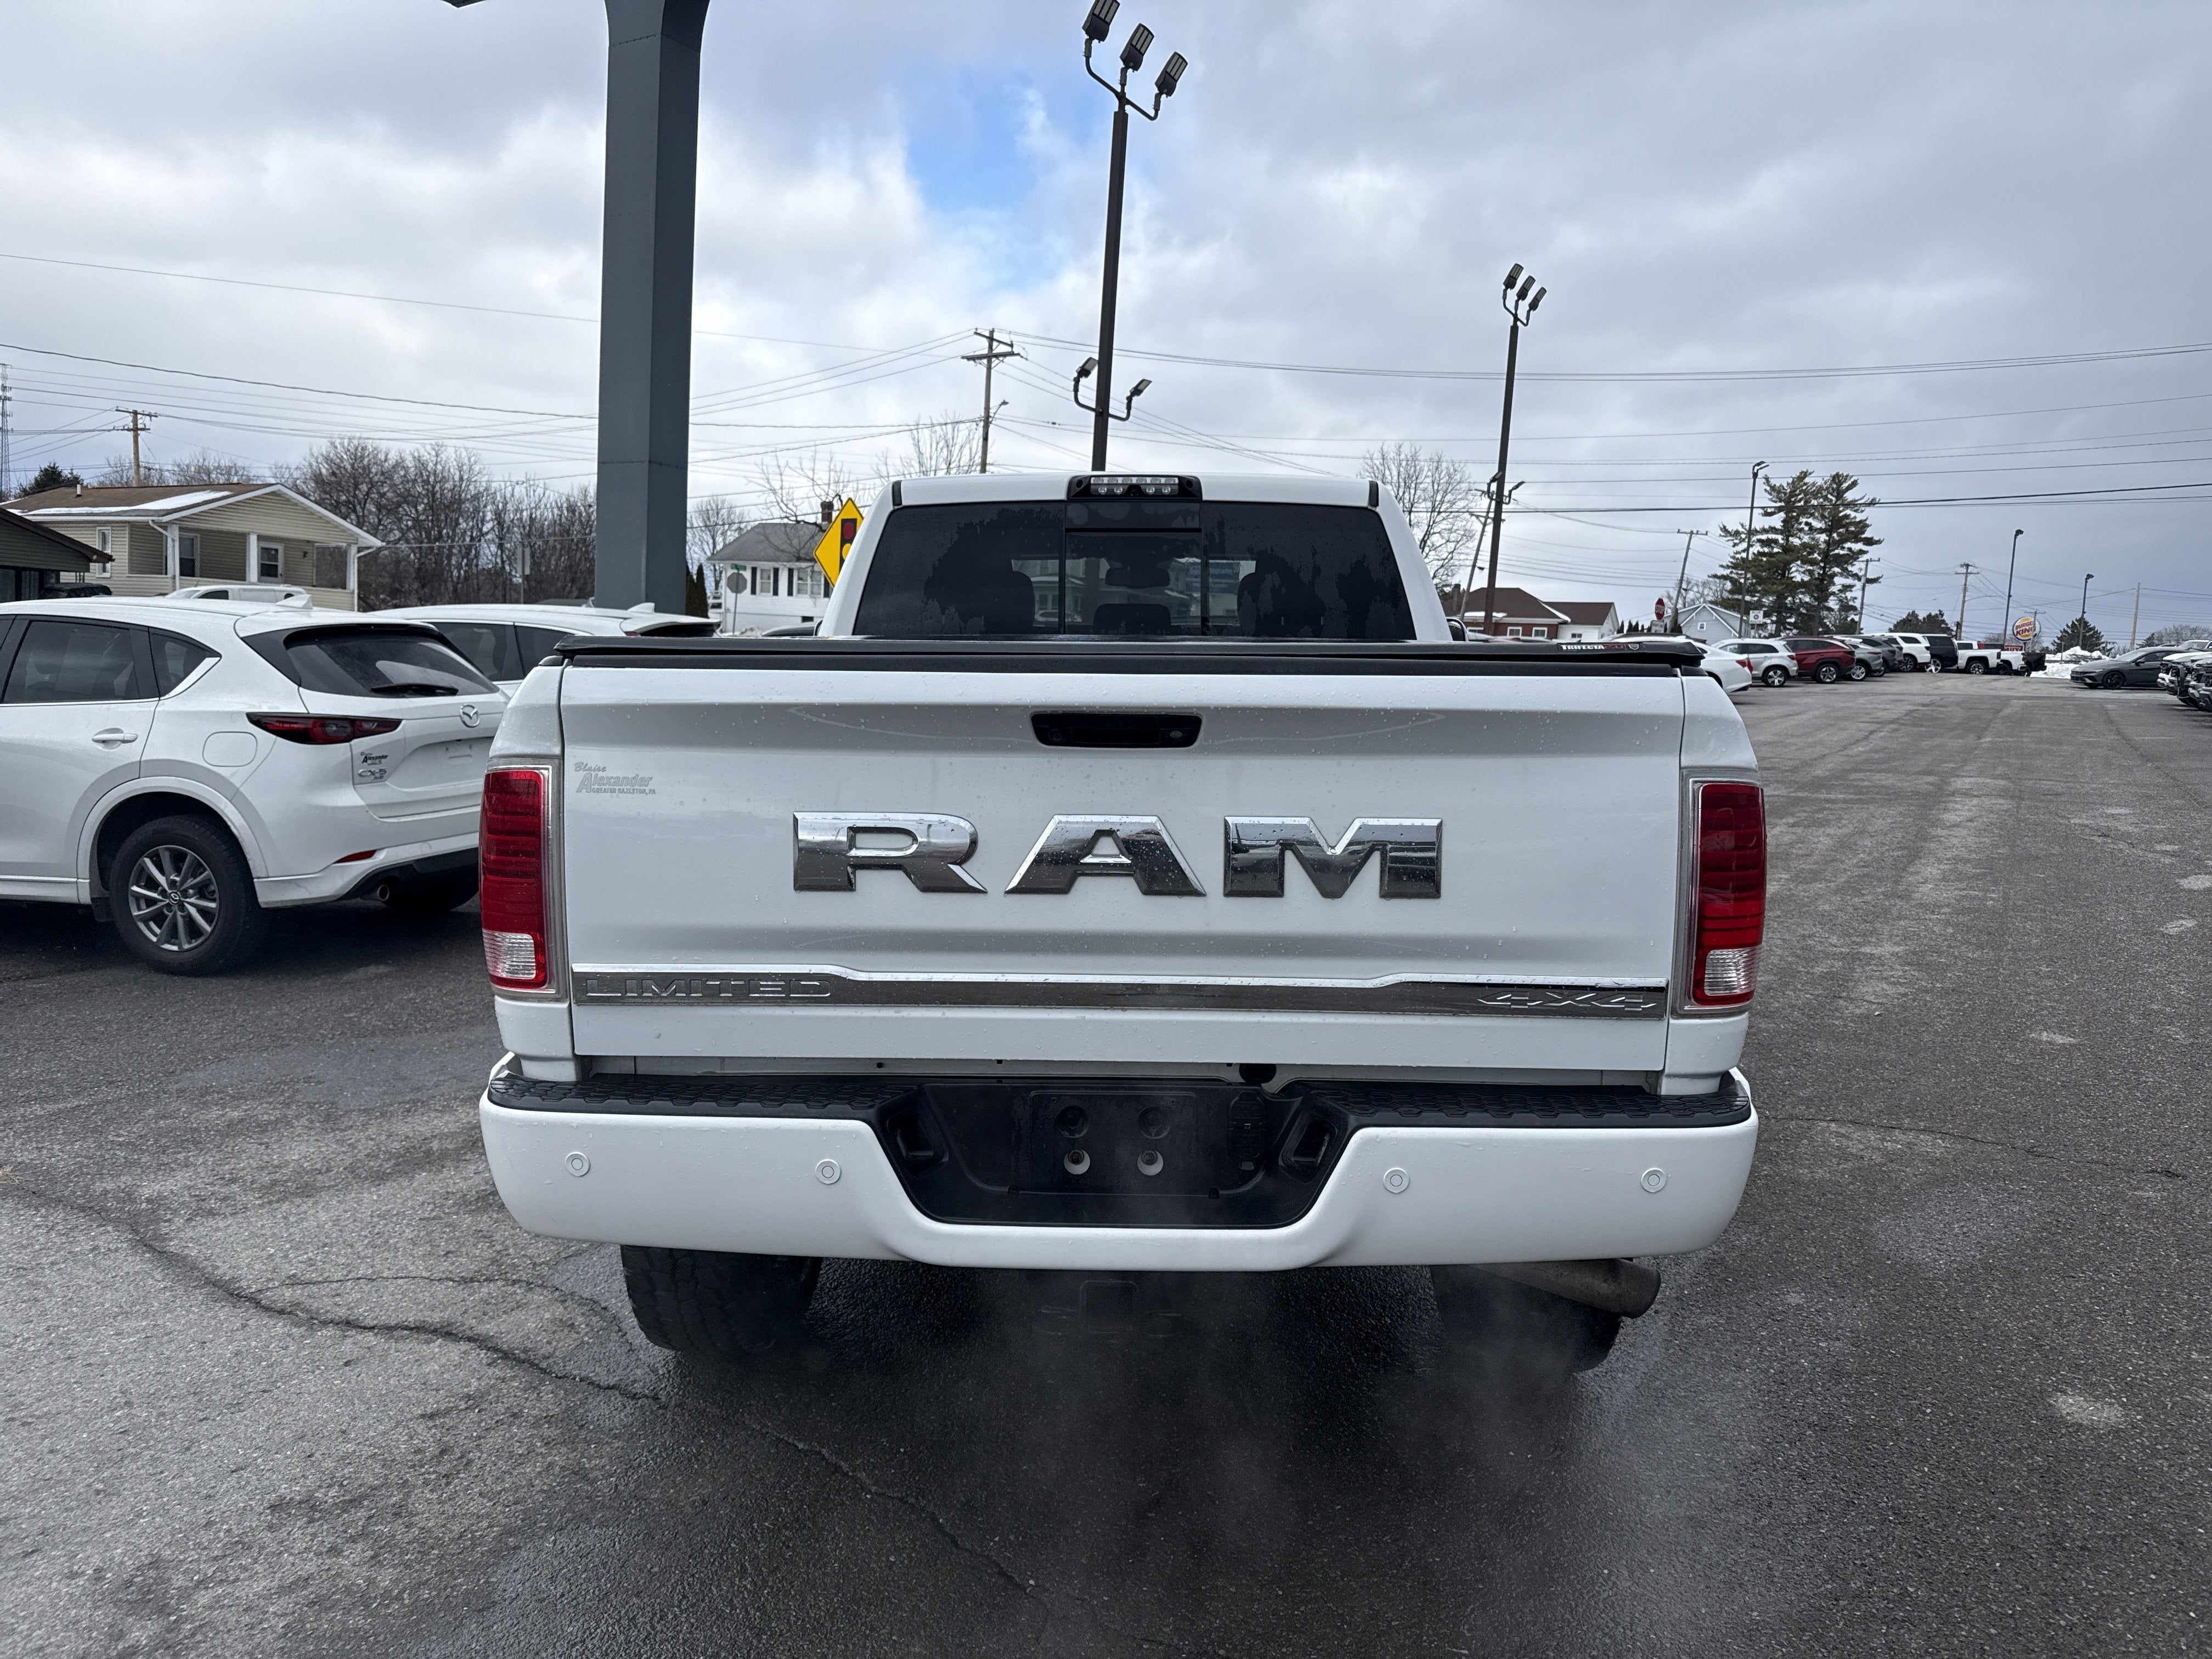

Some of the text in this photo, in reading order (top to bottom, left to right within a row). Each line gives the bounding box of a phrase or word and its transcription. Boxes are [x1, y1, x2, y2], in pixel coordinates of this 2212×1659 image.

[1655, 604, 1664, 614] STOP
[2016, 621, 2035, 630] BURGE
[574, 761, 607, 772] Blaise
[358, 768, 387, 777] CX-5
[576, 772, 653, 793] Alexander
[793, 811, 1443, 898] RAM
[586, 979, 831, 997] LIMITED
